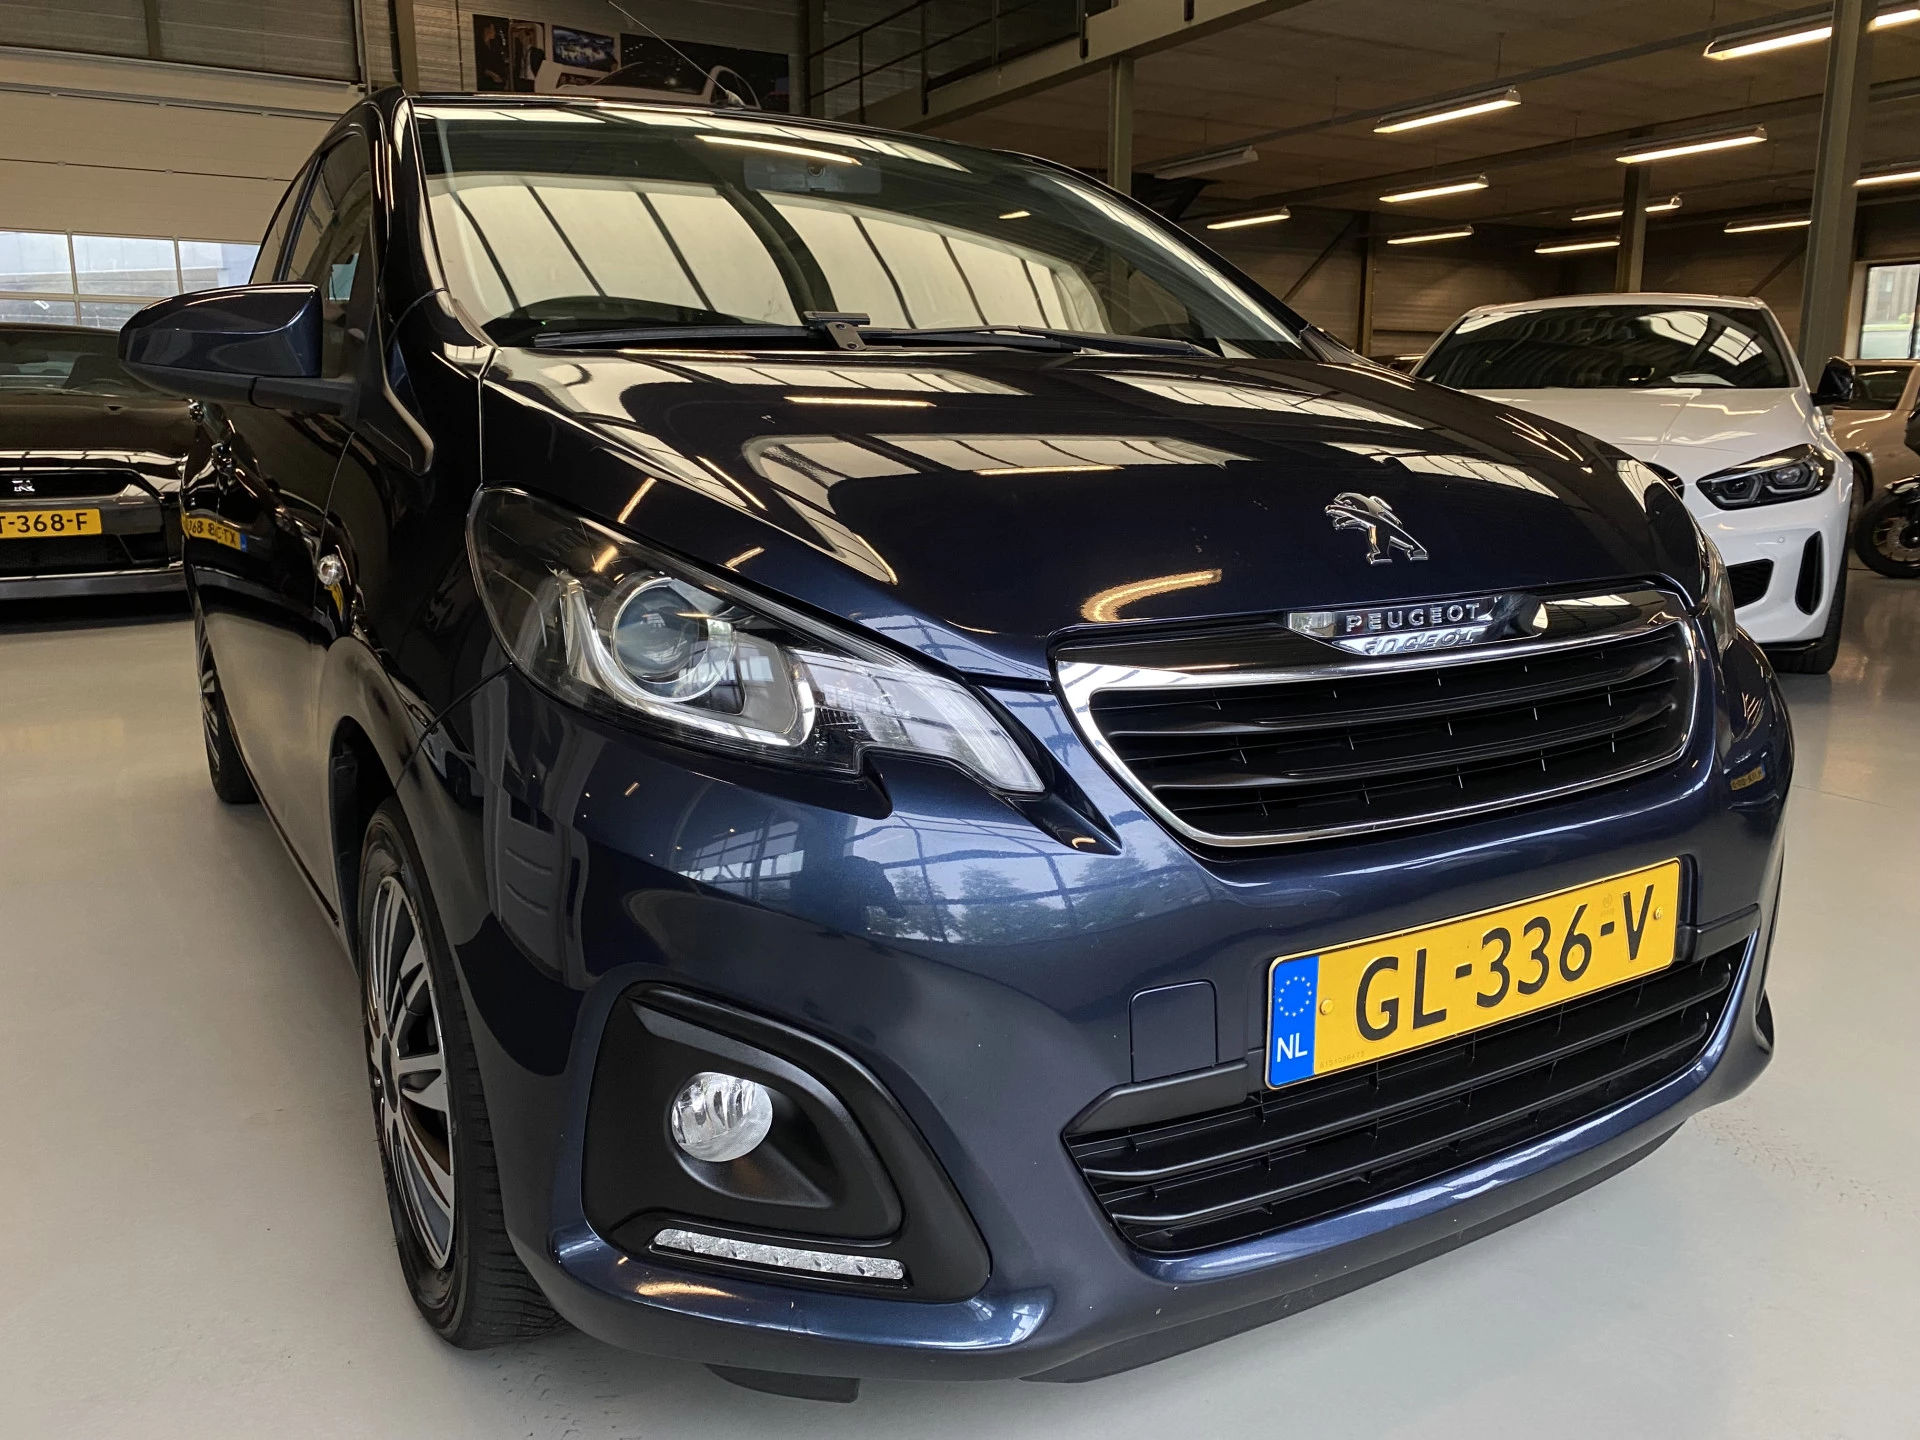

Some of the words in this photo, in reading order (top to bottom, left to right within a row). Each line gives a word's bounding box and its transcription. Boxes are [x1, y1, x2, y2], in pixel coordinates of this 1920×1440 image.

[1345, 602, 1480, 633] PEUGEOT
[1355, 884, 1655, 1042] GL-336-V
[1276, 1033, 1308, 1063] NL
